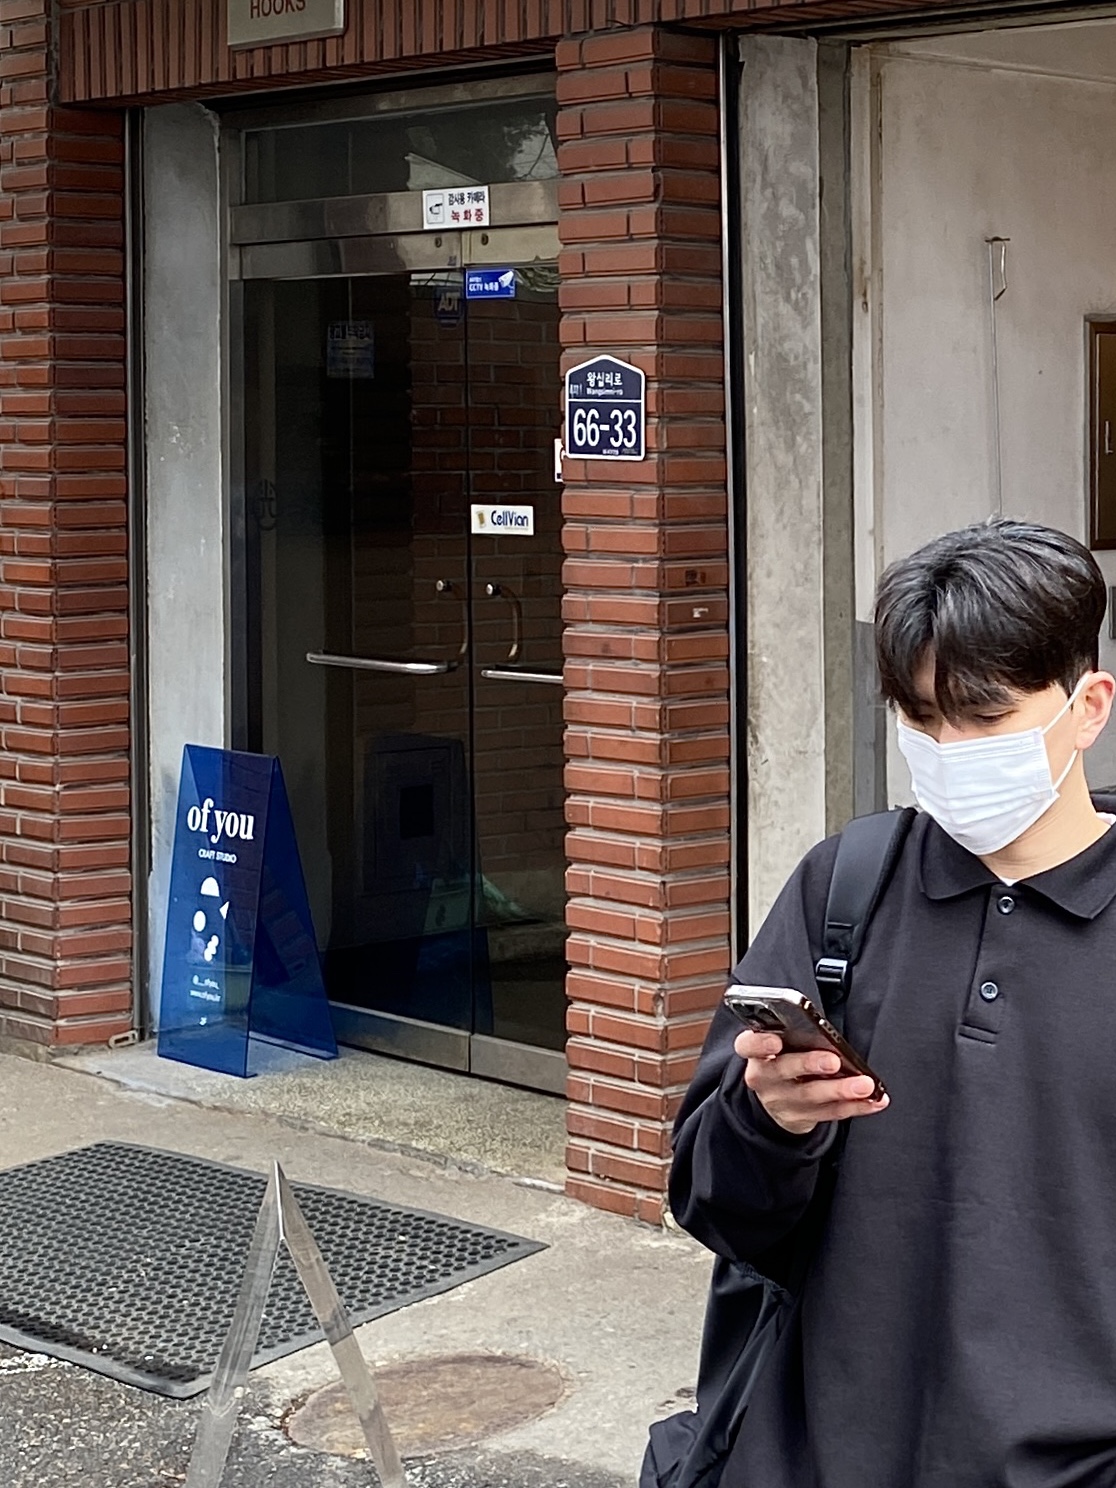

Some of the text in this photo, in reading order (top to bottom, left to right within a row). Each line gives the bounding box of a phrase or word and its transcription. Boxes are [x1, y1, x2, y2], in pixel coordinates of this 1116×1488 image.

[448, 190, 485, 206] 감시용 카메라
[468, 283, 483, 292] CCTV
[586, 371, 623, 388] 왕십리로
[573, 408, 637, 448] 66-33
[490, 510, 529, 527] CellVian
[187, 798, 255, 844] of you
[198, 848, 237, 864] CRAFT STUDIO
